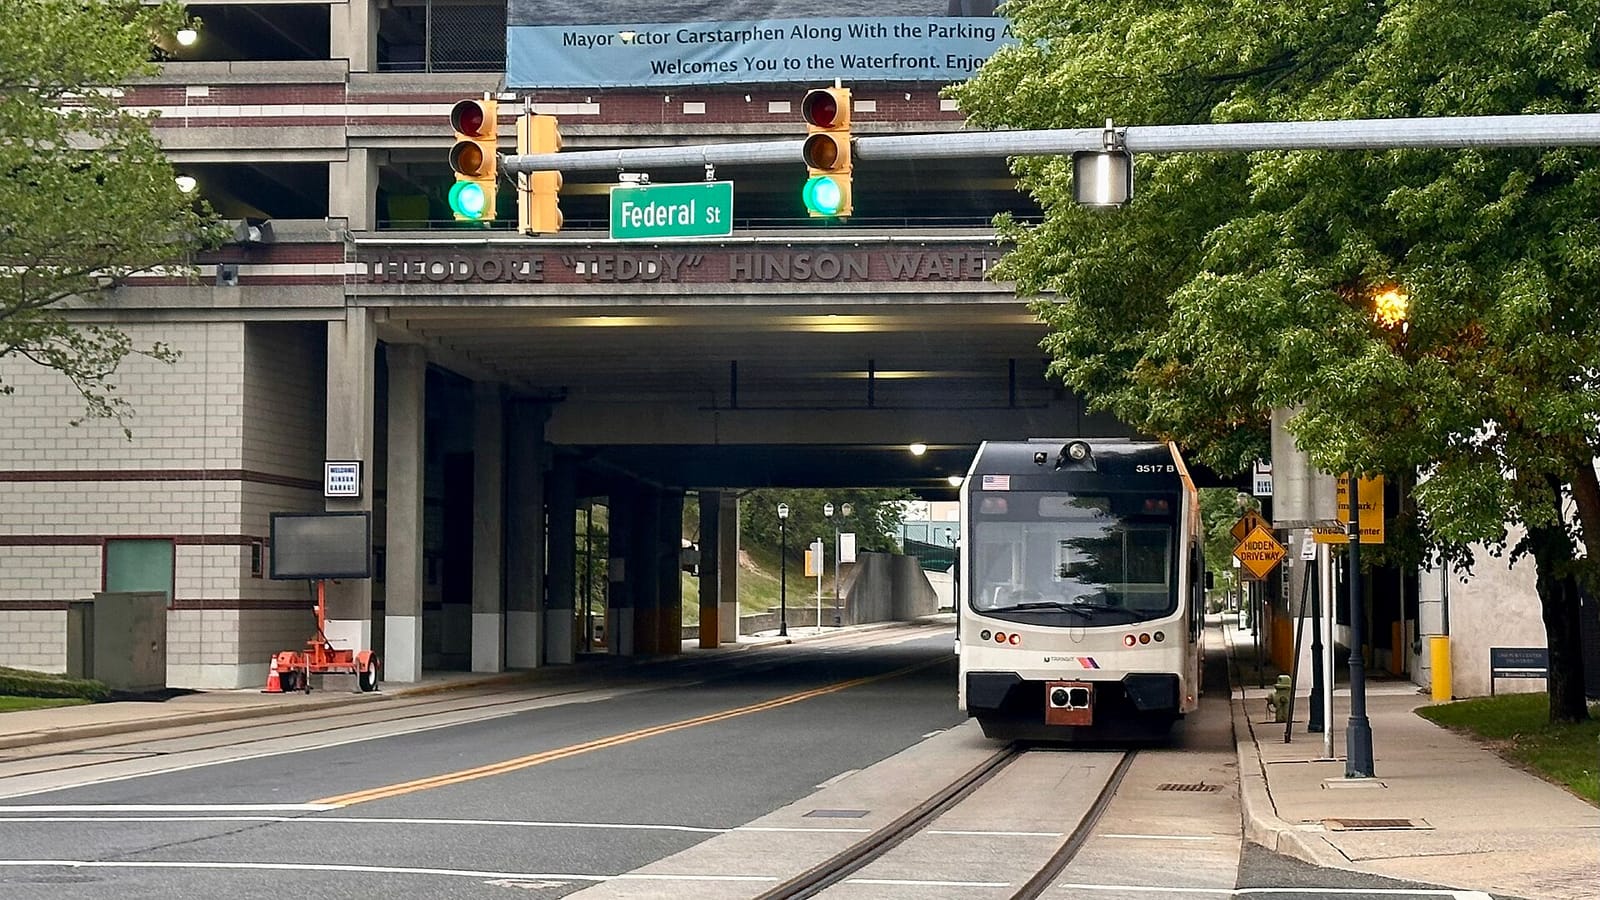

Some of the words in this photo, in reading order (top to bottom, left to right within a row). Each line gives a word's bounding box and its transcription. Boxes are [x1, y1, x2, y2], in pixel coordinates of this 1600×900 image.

[563, 31, 614, 49] Mayor
[676, 27, 784, 44] Carstarphen
[790, 24, 842, 41] Along
[848, 23, 887, 38] With
[894, 23, 922, 38] the
[928, 23, 995, 42] Parking
[650, 59, 738, 74] Welcomes
[744, 57, 777, 72] You
[784, 57, 800, 70] to
[807, 55, 835, 69] the
[841, 54, 940, 69] Waterfront.
[947, 54, 987, 72] Enjo
[622, 199, 695, 228] Federal
[706, 206, 721, 223] St
[365, 254, 545, 282] THEODORE
[729, 252, 869, 281] HINSON
[1136, 464, 1163, 473] 3517
[1166, 464, 1175, 473] B
[1359, 527, 1381, 535] enter
[1244, 541, 1274, 551] HIDDEN
[1240, 551, 1280, 561] DRIVEWAY
